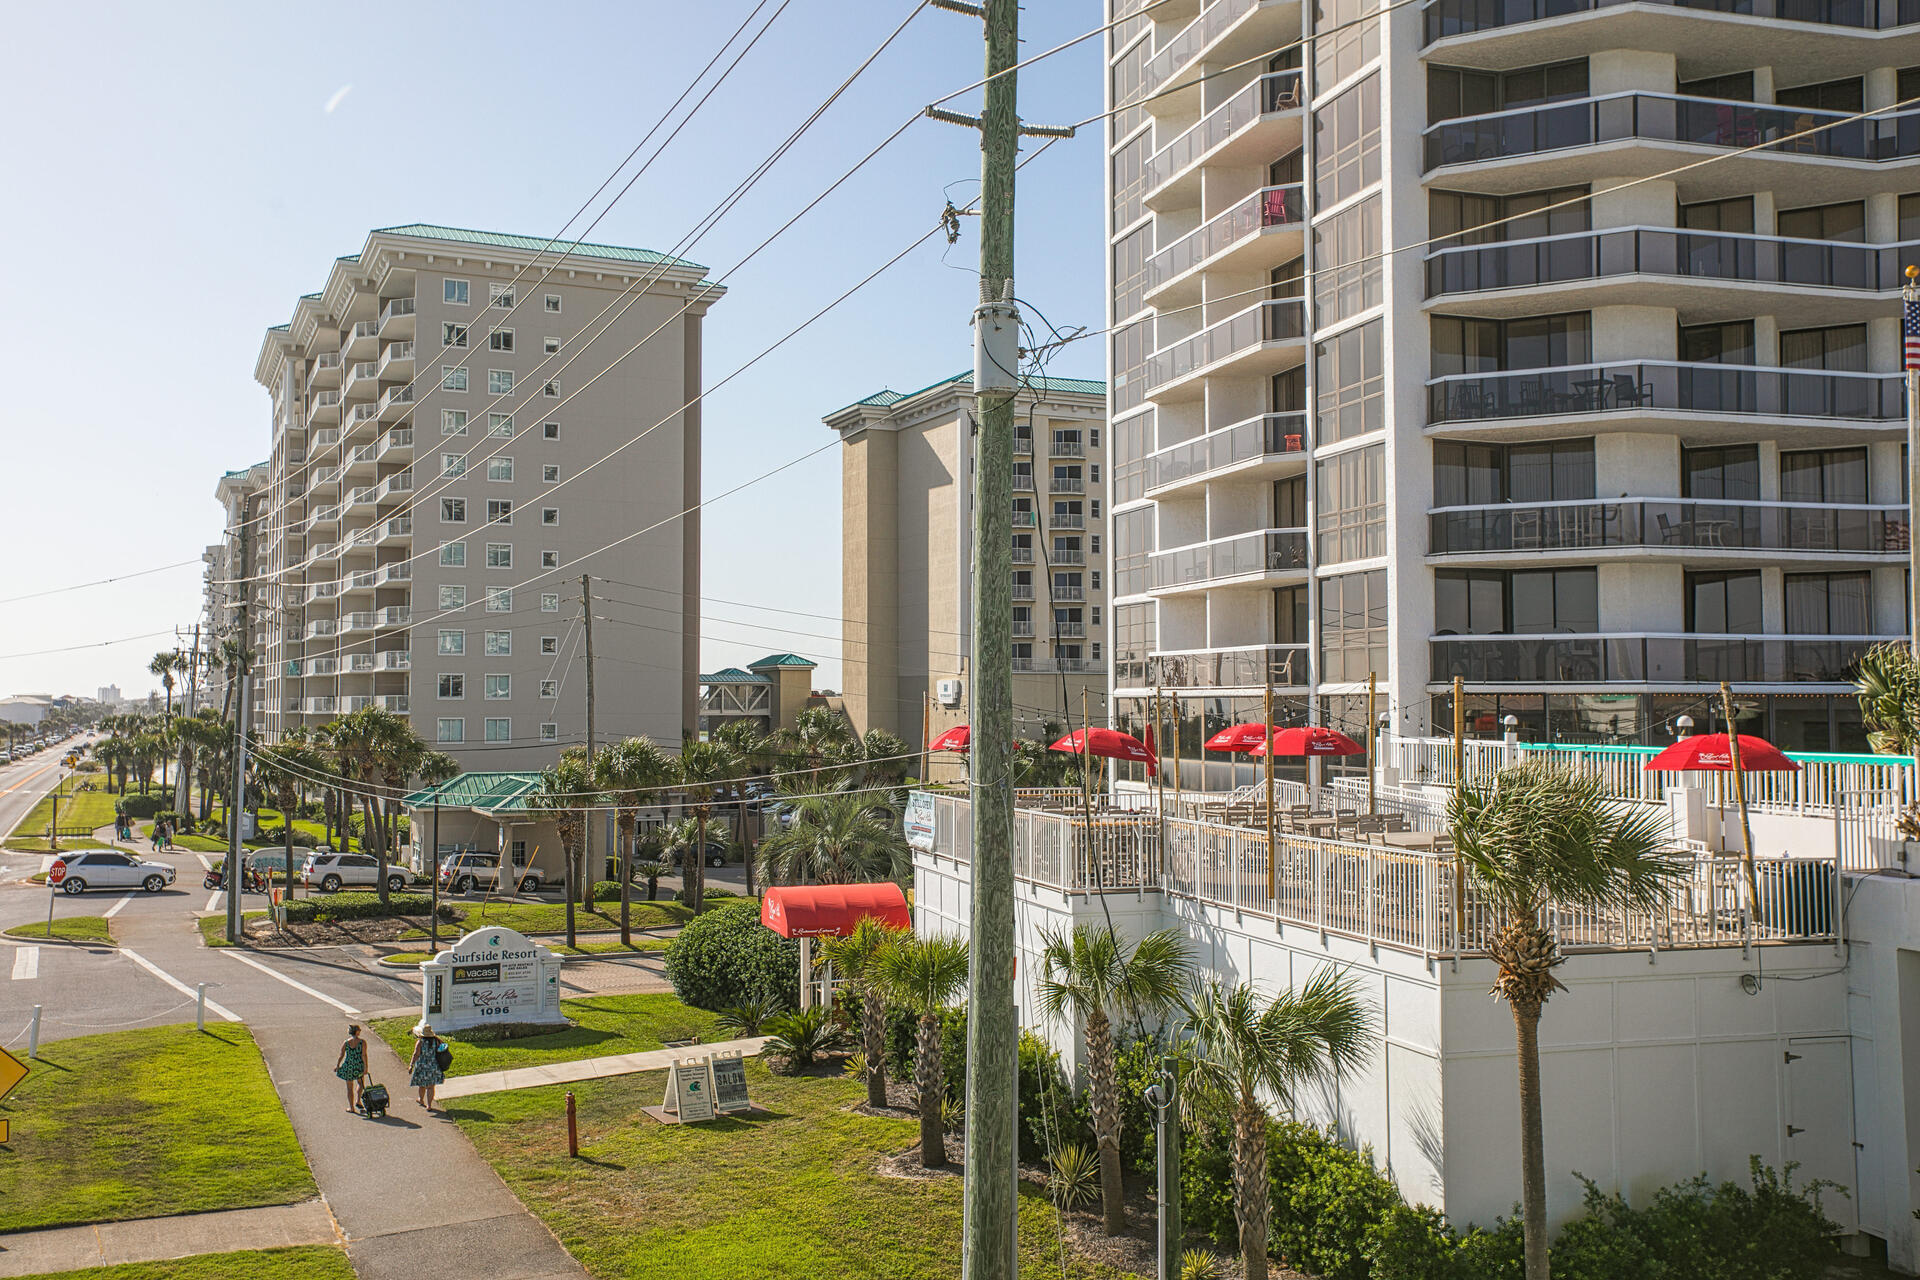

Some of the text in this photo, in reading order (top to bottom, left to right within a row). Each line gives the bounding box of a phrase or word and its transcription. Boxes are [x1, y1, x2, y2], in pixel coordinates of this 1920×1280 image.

[50, 867, 66, 877] STOP
[452, 950, 538, 964] Surfside Resort
[466, 968, 498, 977] vacasa
[481, 1006, 510, 1016] 1096
[717, 1071, 744, 1086] SALON
